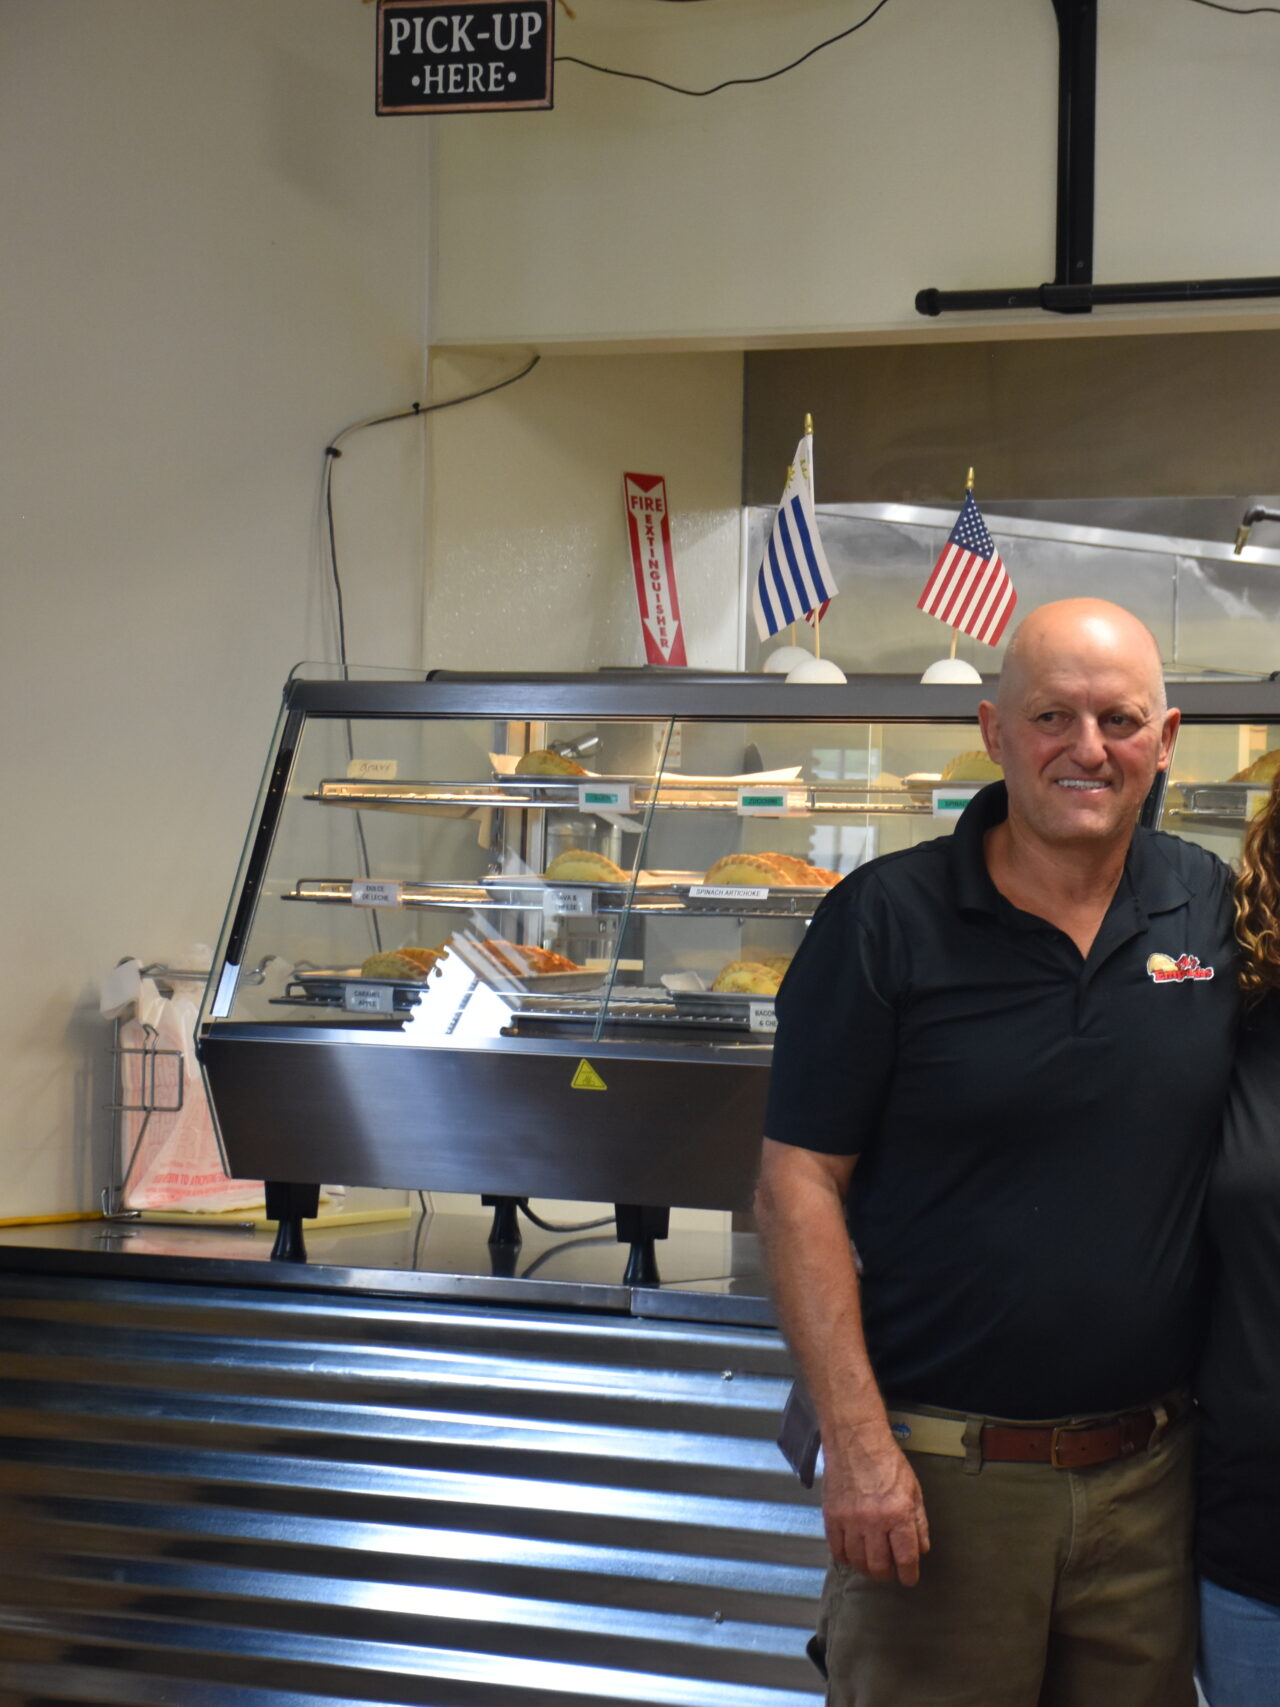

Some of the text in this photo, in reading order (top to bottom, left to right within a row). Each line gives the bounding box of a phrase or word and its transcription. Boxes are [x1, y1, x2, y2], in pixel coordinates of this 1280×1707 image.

[389, 11, 542, 55] PICK-UP
[423, 62, 505, 94] HERE
[631, 495, 663, 512] FIRE
[644, 514, 670, 649] EXTINGUISHER
[724, 889, 760, 897] ARTICHOKE
